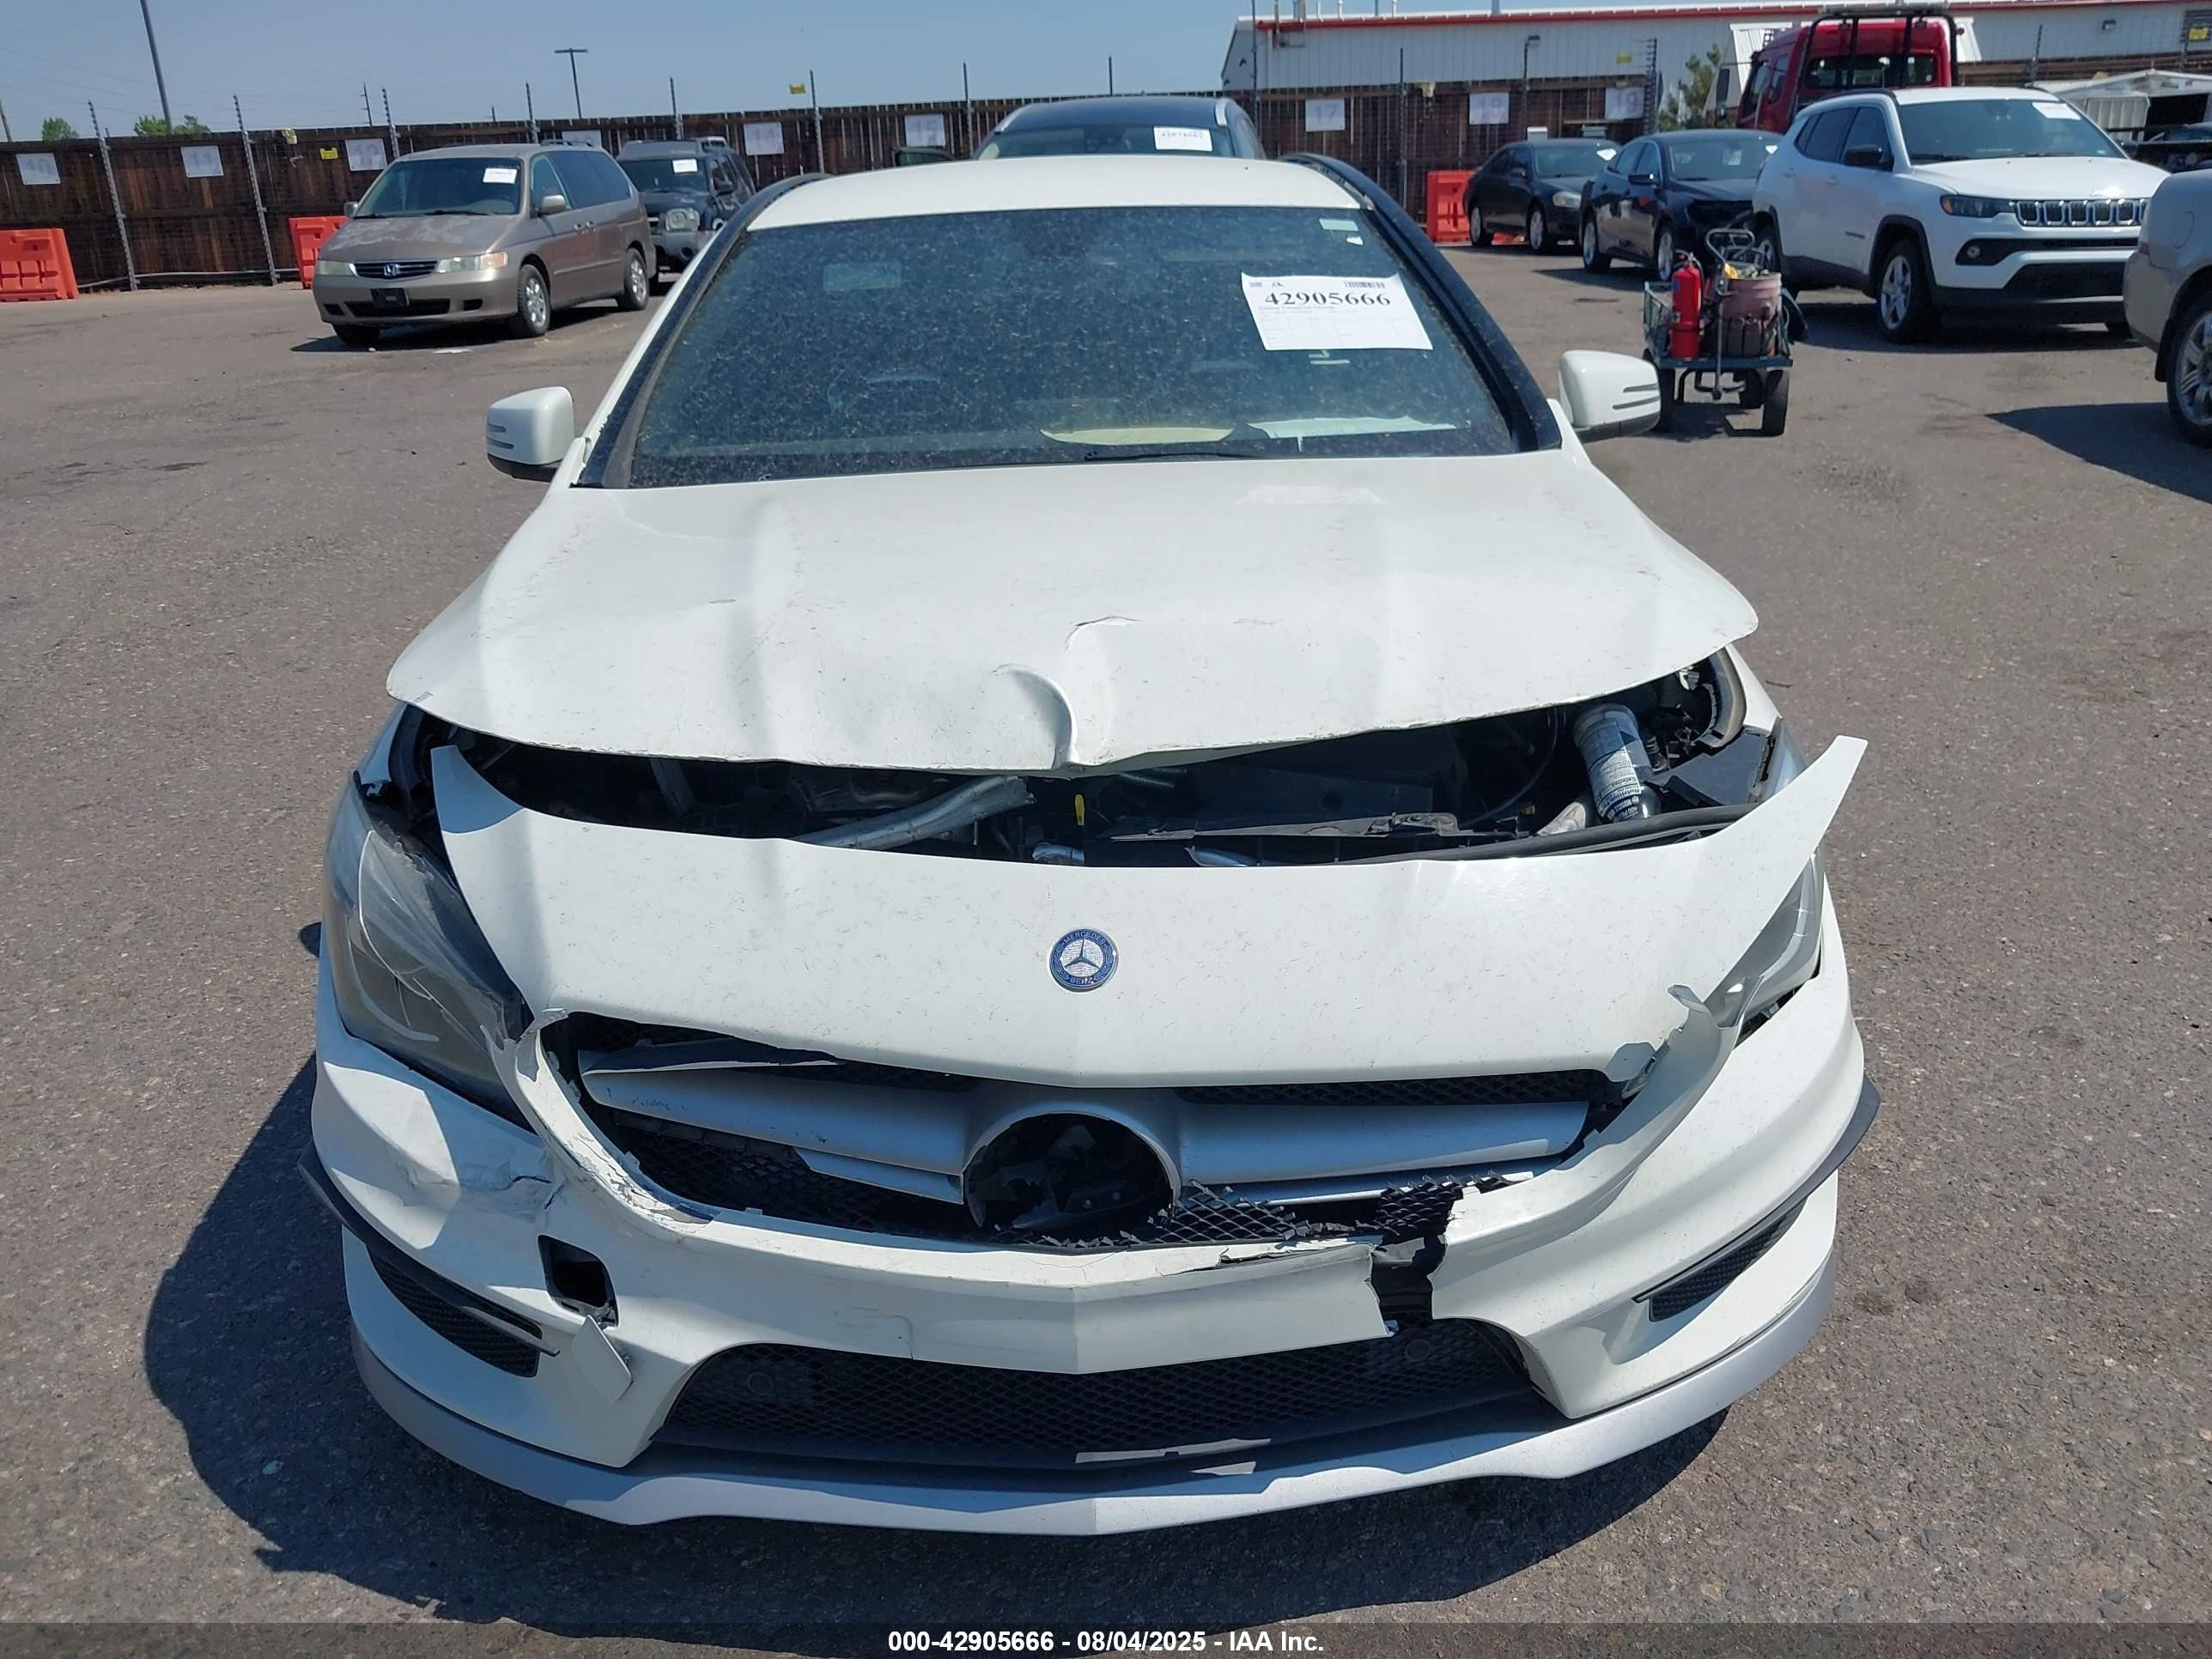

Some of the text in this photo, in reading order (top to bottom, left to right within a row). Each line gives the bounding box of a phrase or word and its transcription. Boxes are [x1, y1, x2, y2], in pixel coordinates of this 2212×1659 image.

[1613, 90, 1638, 112] 19
[1314, 104, 1338, 125] 17
[1265, 292, 1391, 306] 42905666
[1064, 931, 1107, 945] MERCEDES
